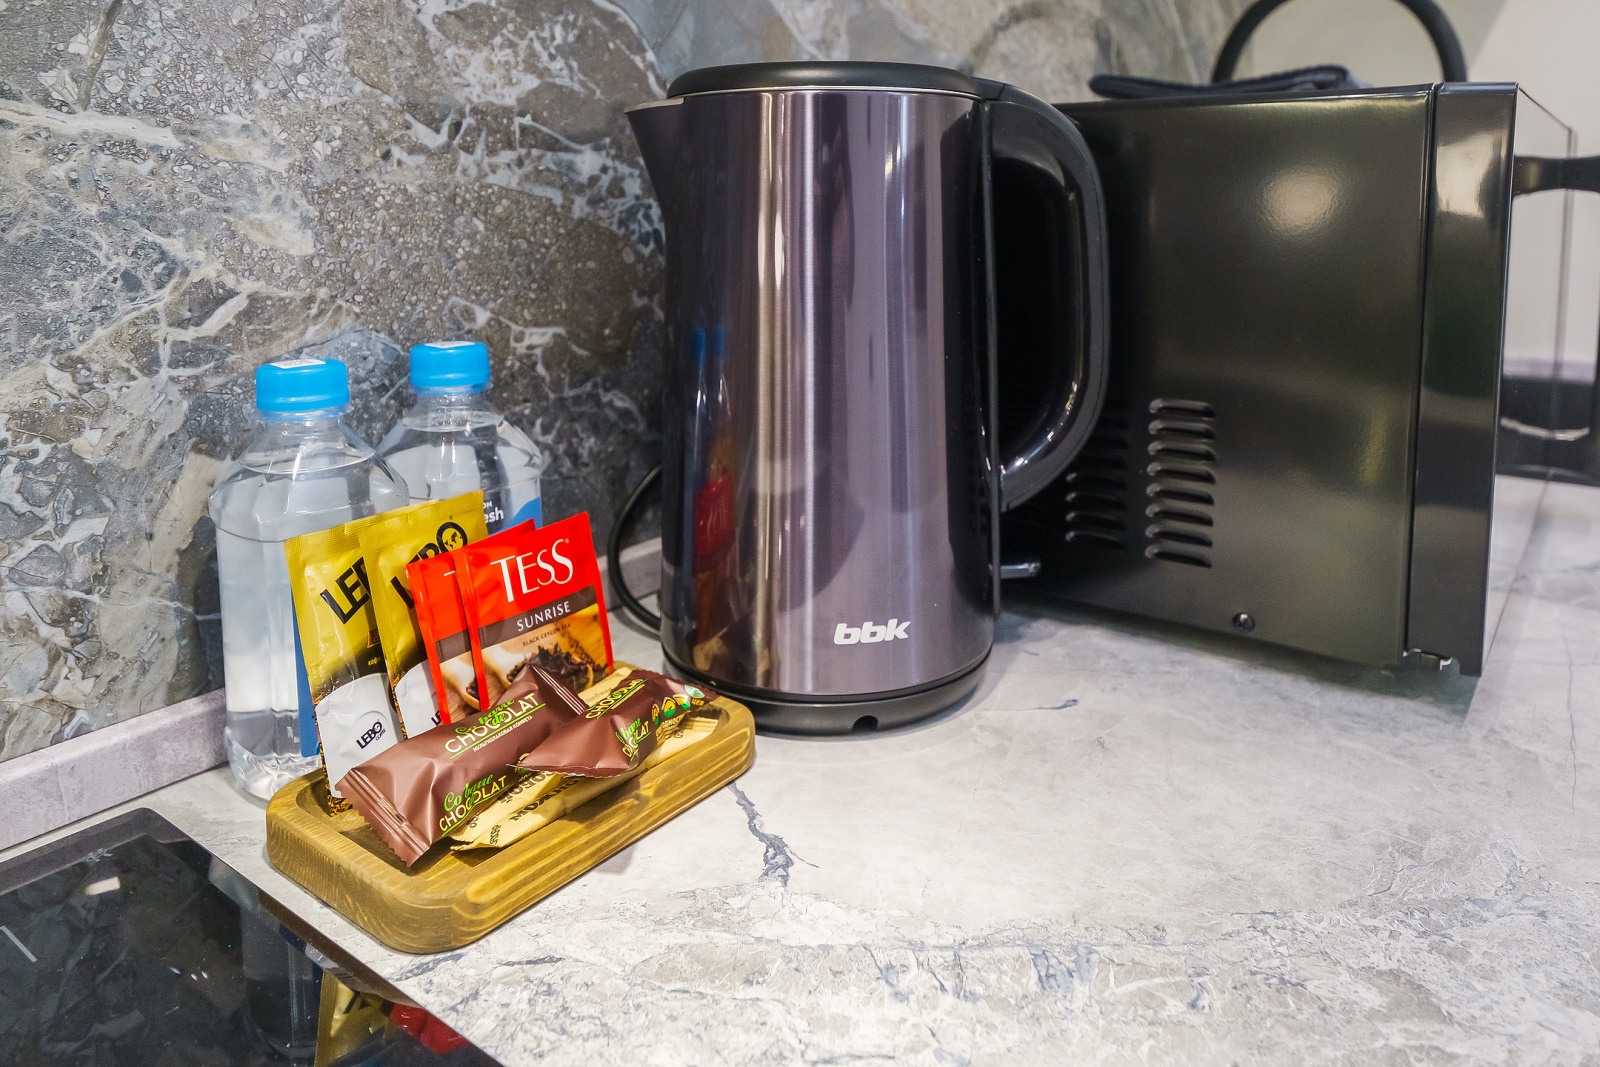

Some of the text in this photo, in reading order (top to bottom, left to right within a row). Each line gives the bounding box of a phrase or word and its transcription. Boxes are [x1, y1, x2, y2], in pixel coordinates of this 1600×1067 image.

[490, 539, 574, 603] TESS
[516, 601, 571, 632] SUNRISE
[833, 618, 912, 645] bbk
[356, 721, 383, 750] LEBO
[444, 692, 540, 753] CHOCOLAT
[439, 775, 507, 832] CHOCOLAT
